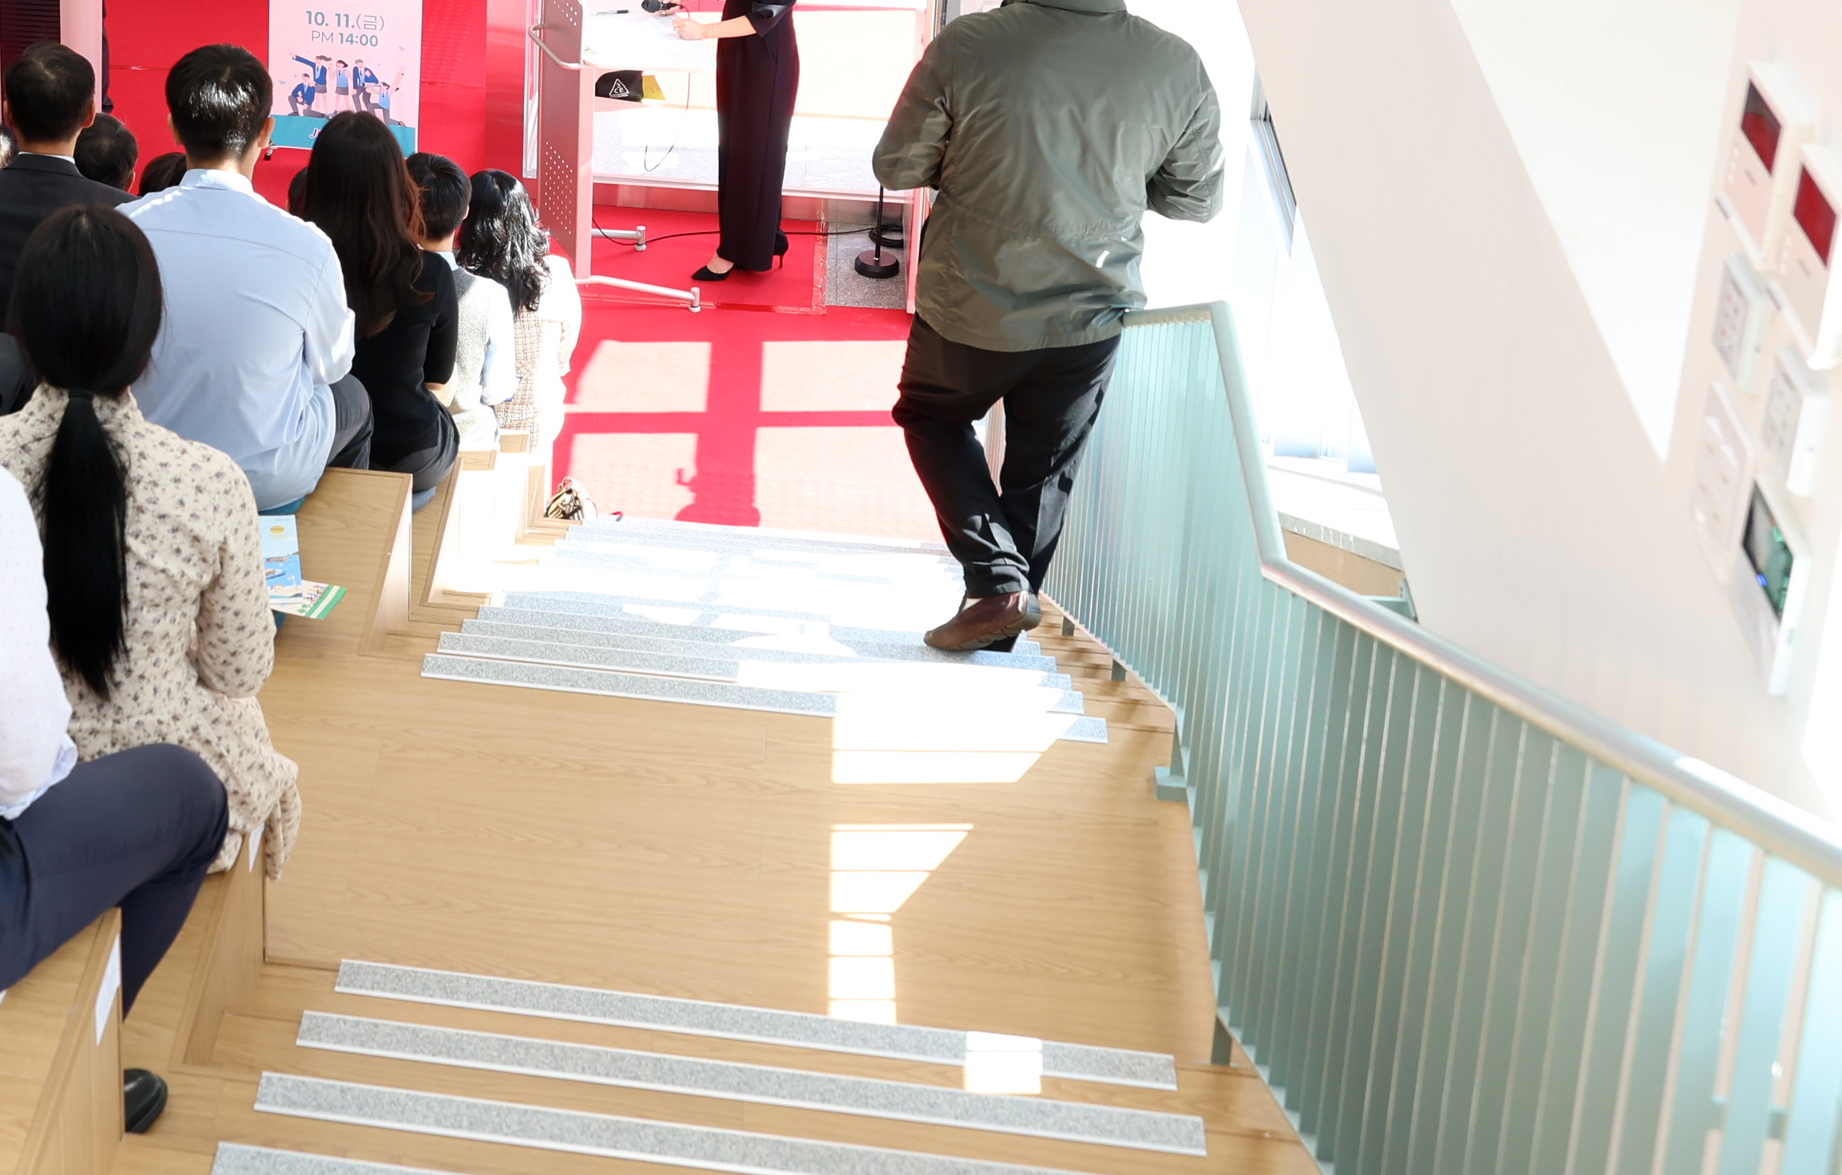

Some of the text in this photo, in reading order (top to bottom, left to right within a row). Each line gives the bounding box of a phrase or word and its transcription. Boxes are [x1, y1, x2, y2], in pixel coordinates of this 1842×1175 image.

[305, 10, 385, 31] 10. 11.(금)
[311, 30, 379, 47] PM 14:00
